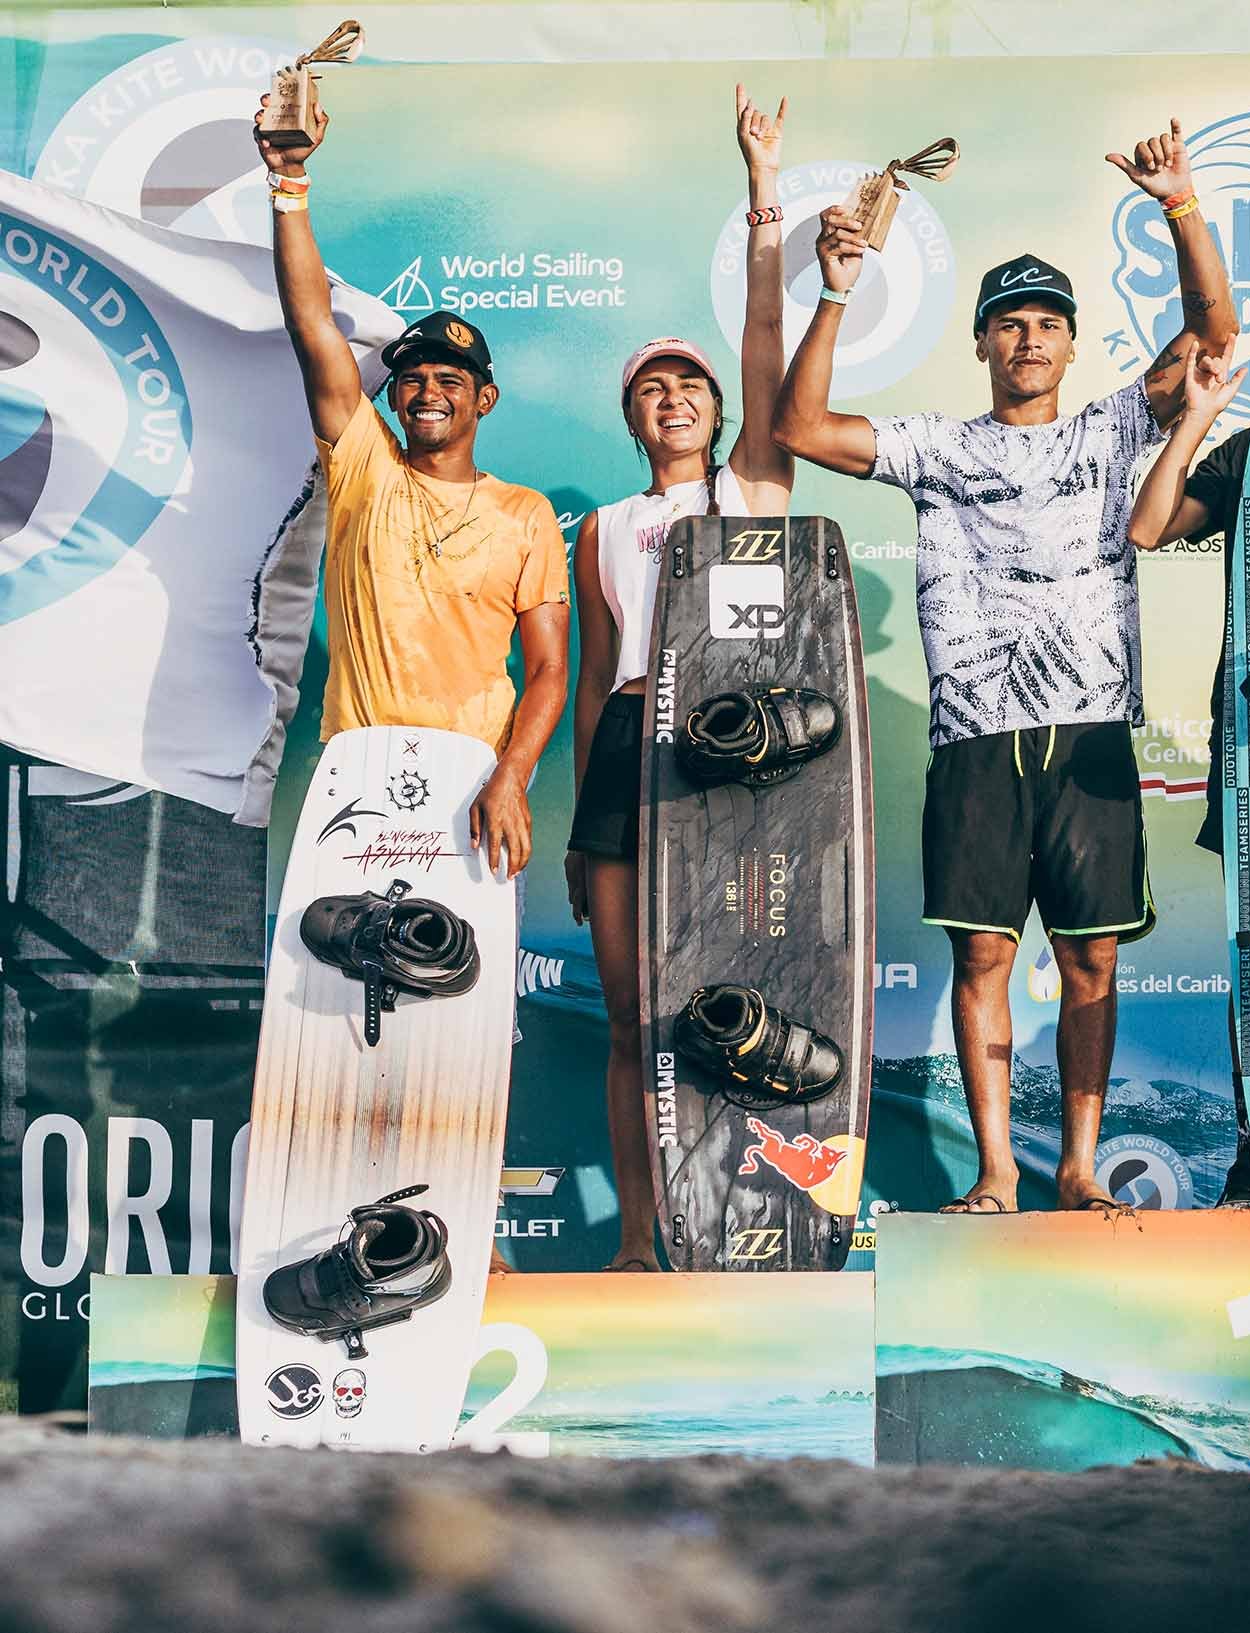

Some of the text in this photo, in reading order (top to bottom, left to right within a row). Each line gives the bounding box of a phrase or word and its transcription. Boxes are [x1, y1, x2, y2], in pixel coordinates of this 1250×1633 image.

[440, 252, 624, 282] World Sailing
[440, 284, 626, 315] Special Event
[0, 228, 179, 465] ORLD TOUR
[850, 540, 917, 560] Caribe
[1174, 537, 1225, 553] ACOS
[655, 666, 677, 744] MYSTIC
[1223, 726, 1237, 788] DUOTONE
[770, 854, 786, 937] FOCUS
[1141, 974, 1172, 993] del
[1176, 974, 1232, 993] Carib
[657, 1070, 678, 1148] MYSTIC
[1123, 1137, 1171, 1158] WORLD
[1170, 1156, 1190, 1191] TOUR
[20, 1112, 250, 1287] ORI
[456, 1322, 549, 1457] 2
